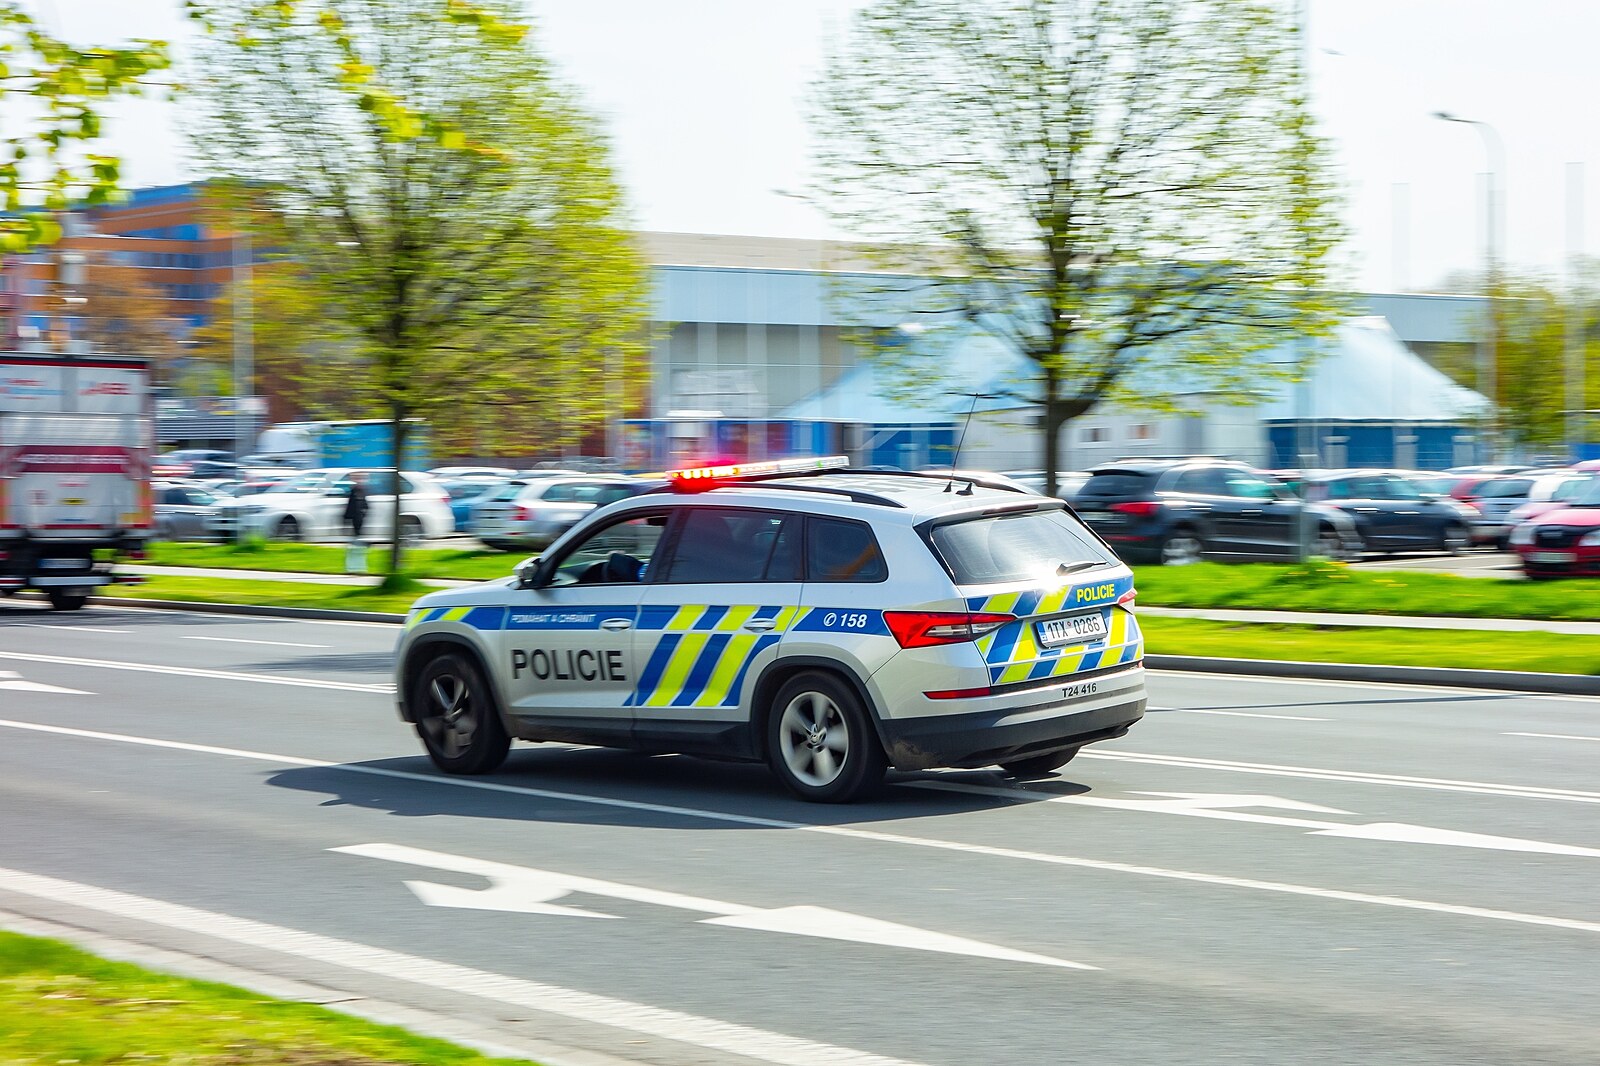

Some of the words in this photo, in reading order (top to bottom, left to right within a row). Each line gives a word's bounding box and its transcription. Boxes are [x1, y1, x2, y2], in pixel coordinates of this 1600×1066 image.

[1076, 584, 1115, 602] POLICIE
[840, 613, 868, 628] 158
[1047, 621, 1069, 639] 1TX
[1073, 616, 1101, 635] 0286
[511, 649, 627, 681] POLICIE
[1062, 686, 1079, 698] T24
[1081, 682, 1097, 694] 416
